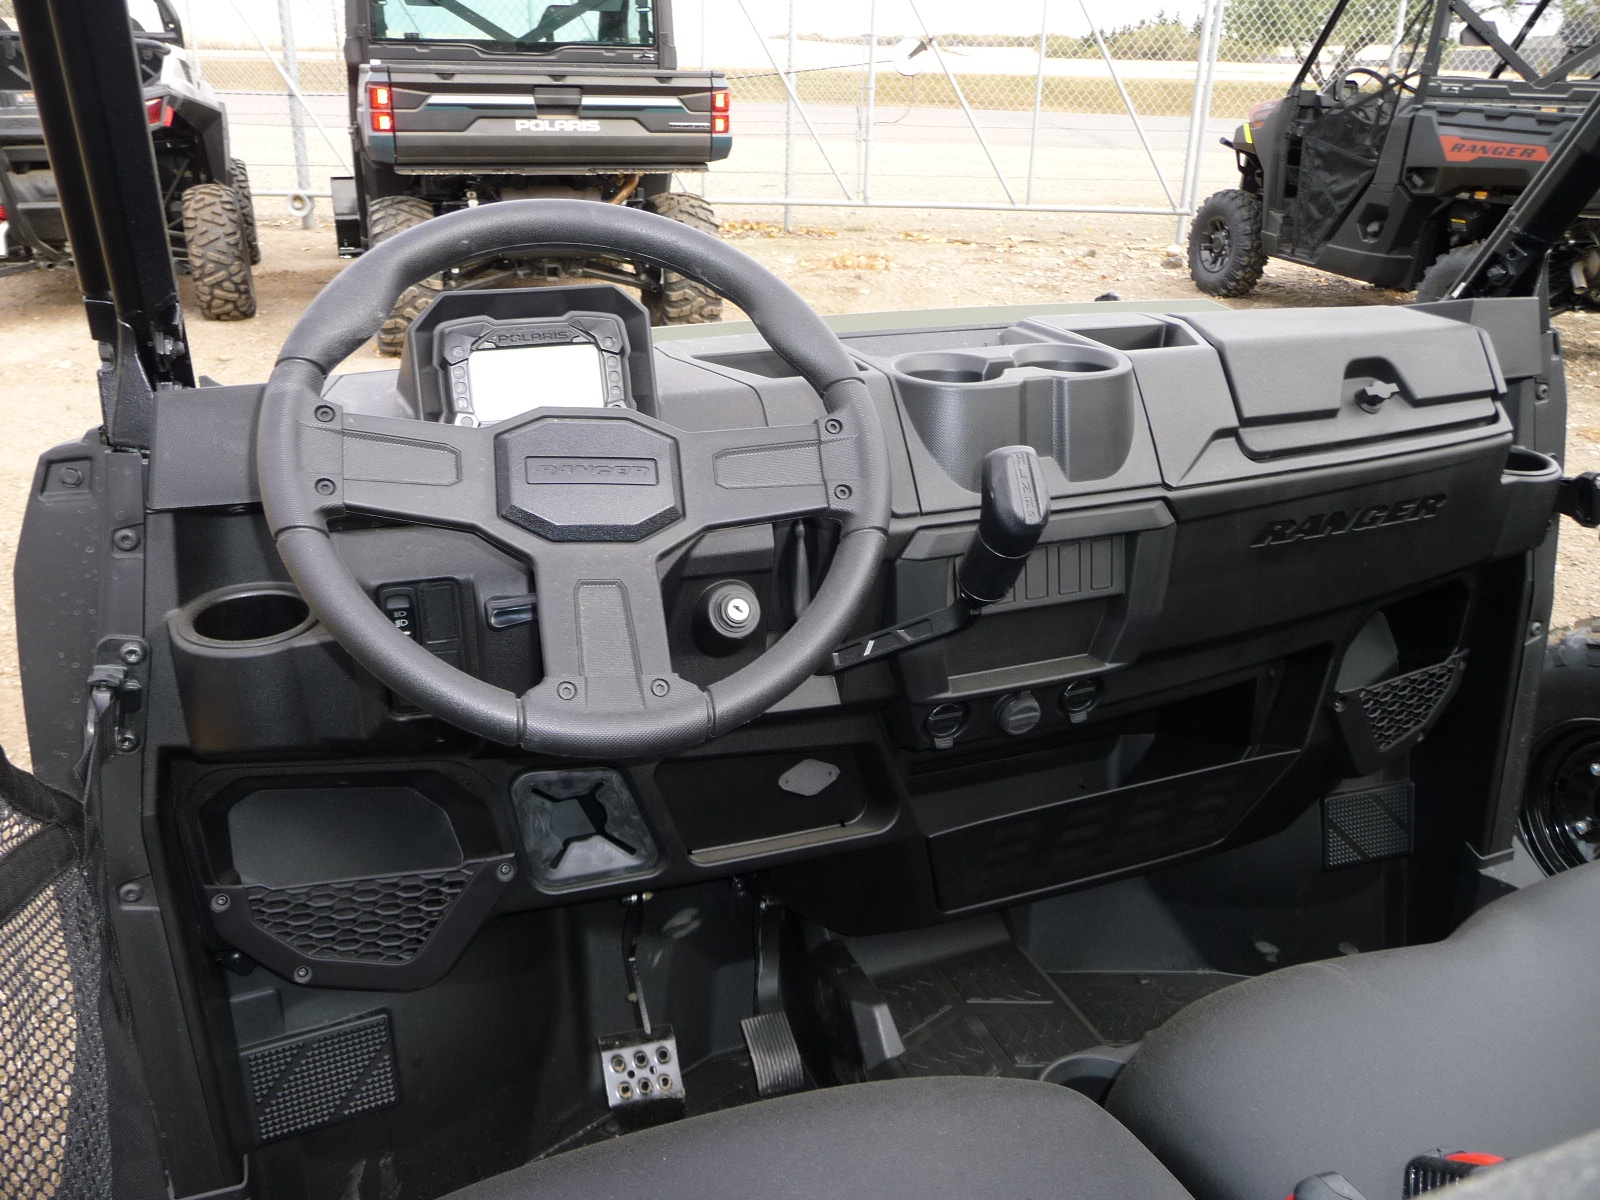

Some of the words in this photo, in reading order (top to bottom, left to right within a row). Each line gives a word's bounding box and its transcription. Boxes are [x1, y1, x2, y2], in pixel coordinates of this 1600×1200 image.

[515, 120, 601, 132] POLARIS
[1450, 143, 1536, 158] RANGER
[499, 331, 568, 343] POLARIS
[535, 464, 650, 479] RANGER
[1250, 493, 1447, 548] RANGER
